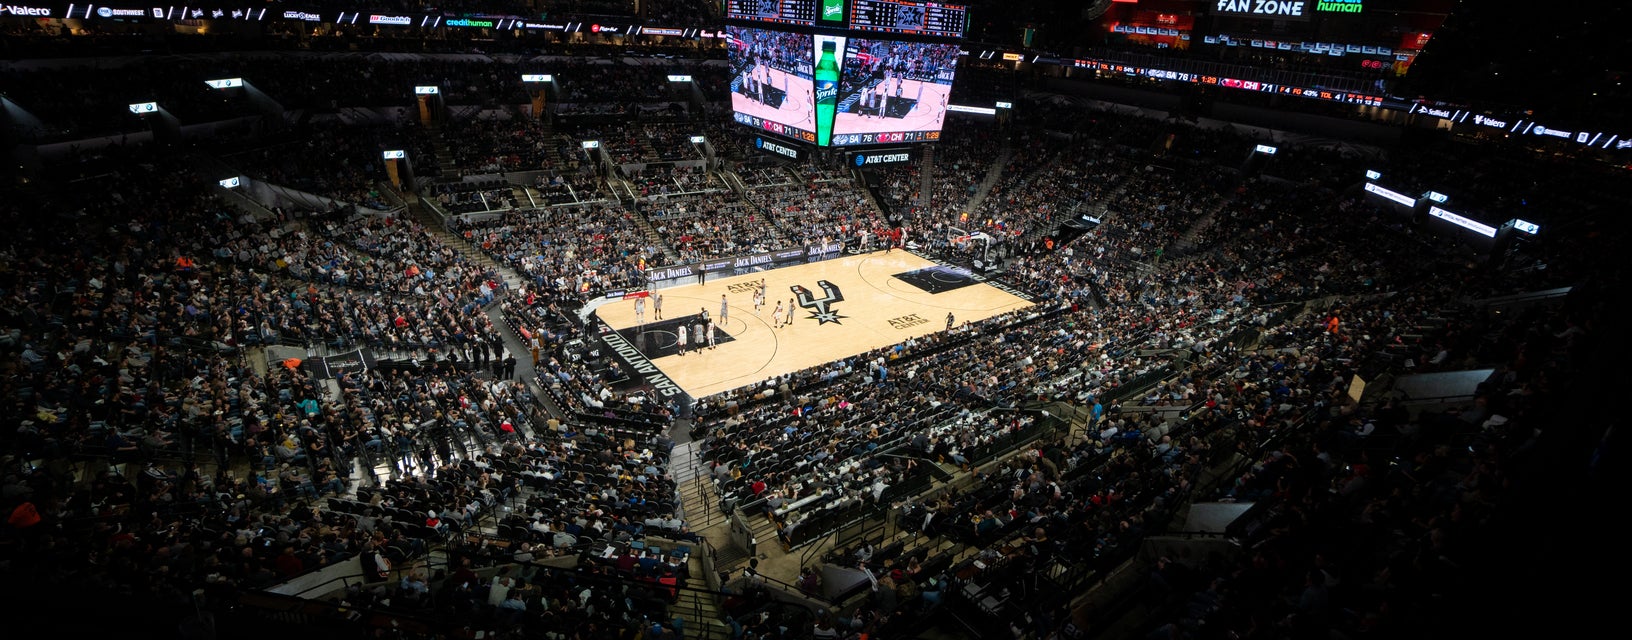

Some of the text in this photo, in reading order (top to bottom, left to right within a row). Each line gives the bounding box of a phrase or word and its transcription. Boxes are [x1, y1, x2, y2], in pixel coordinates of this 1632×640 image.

[7, 5, 51, 16] Valero
[1217, 0, 1304, 16] FAN ZONE
[1317, 0, 1363, 13] human
[1166, 71, 1177, 80] SA
[1178, 72, 1189, 81] 76
[1201, 75, 1217, 84] 1:29
[816, 83, 838, 100] Sprite
[1243, 82, 1258, 90] CHI
[1261, 83, 1273, 92] 71
[1483, 116, 1505, 128] Valero
[784, 126, 792, 135] 71
[849, 135, 859, 143] SA
[863, 134, 872, 142] 76
[891, 132, 902, 141] CHI
[905, 132, 914, 140] 71
[762, 141, 797, 158] AT&T CENTER
[865, 153, 909, 164] AT&T CENTER
[808, 246, 822, 256] JACK
[734, 257, 750, 268] JACK
[751, 254, 773, 265] DANIEL'S
[650, 266, 693, 281] JACK DANIEL'S
[727, 279, 761, 291] AT&T
[987, 280, 1034, 300] SPURS
[887, 313, 922, 326] AT&T
[894, 318, 930, 330] CENTER
[601, 333, 682, 397] SAN ANTONIO
